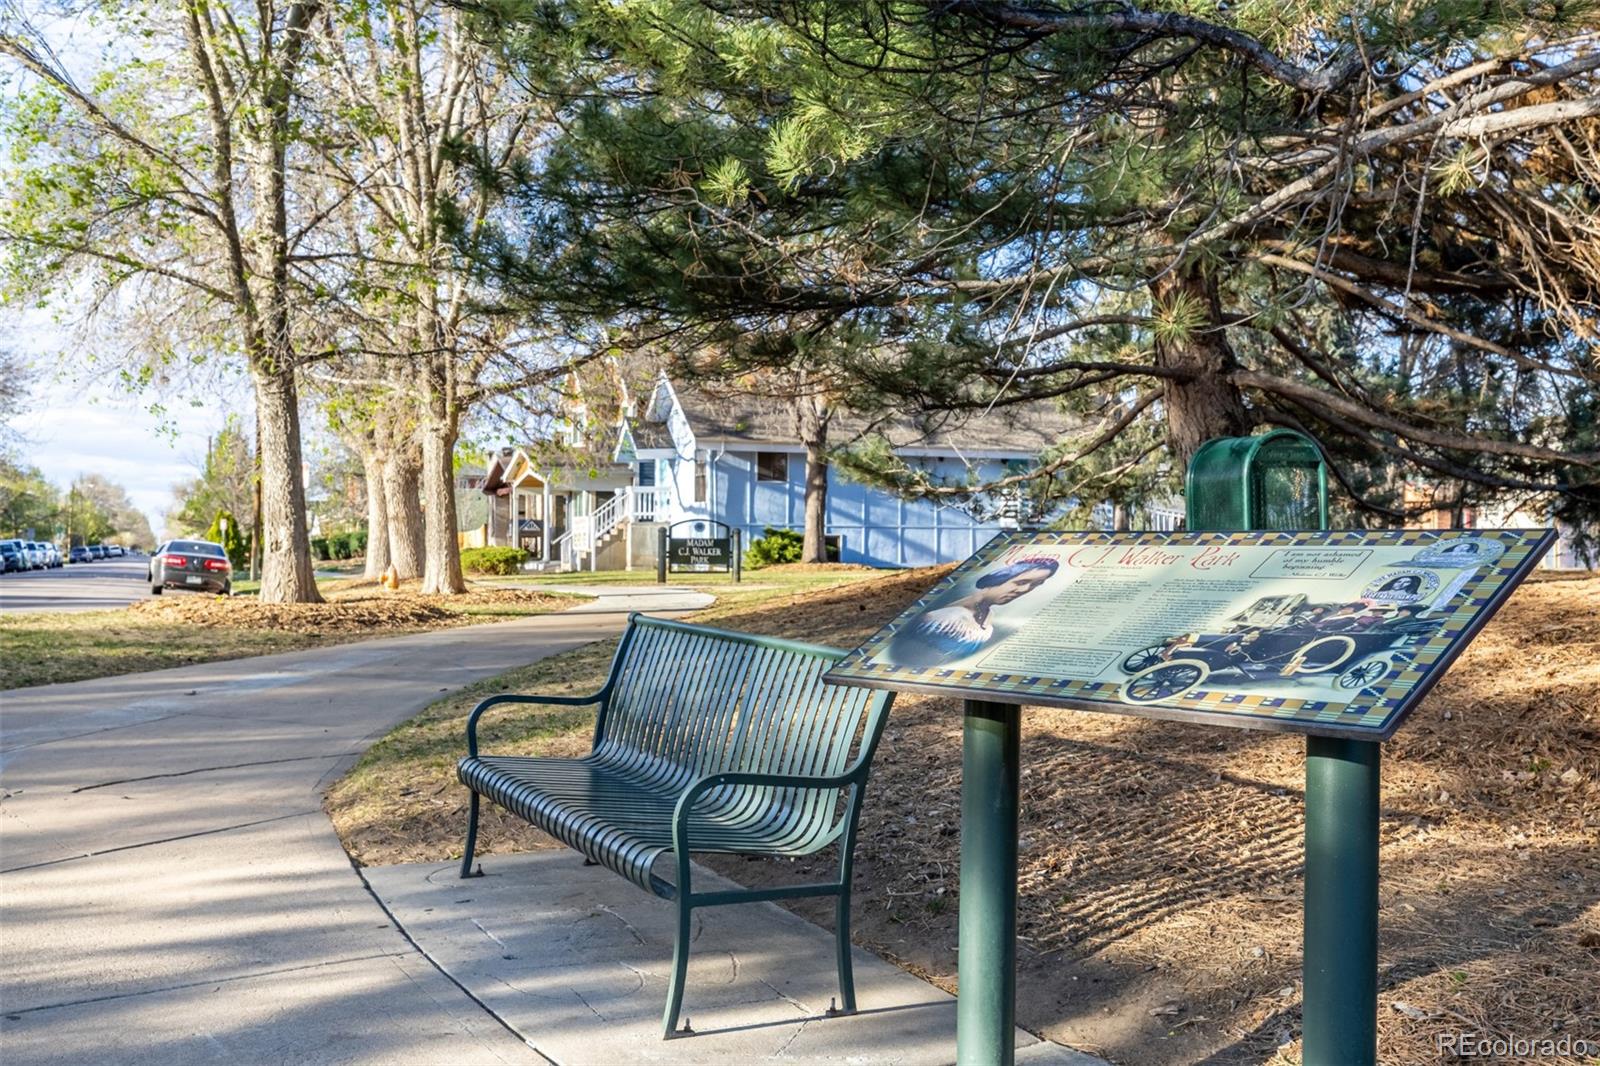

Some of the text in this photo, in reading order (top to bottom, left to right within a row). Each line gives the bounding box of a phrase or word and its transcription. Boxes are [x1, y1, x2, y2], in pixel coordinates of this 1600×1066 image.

[686, 539, 714, 547] MADAM
[692, 547, 722, 556] WALKER
[690, 556, 709, 564] PARK
[995, 545, 1061, 566] Madam
[1118, 545, 1184, 566] Walker
[1190, 546, 1240, 570] Park
